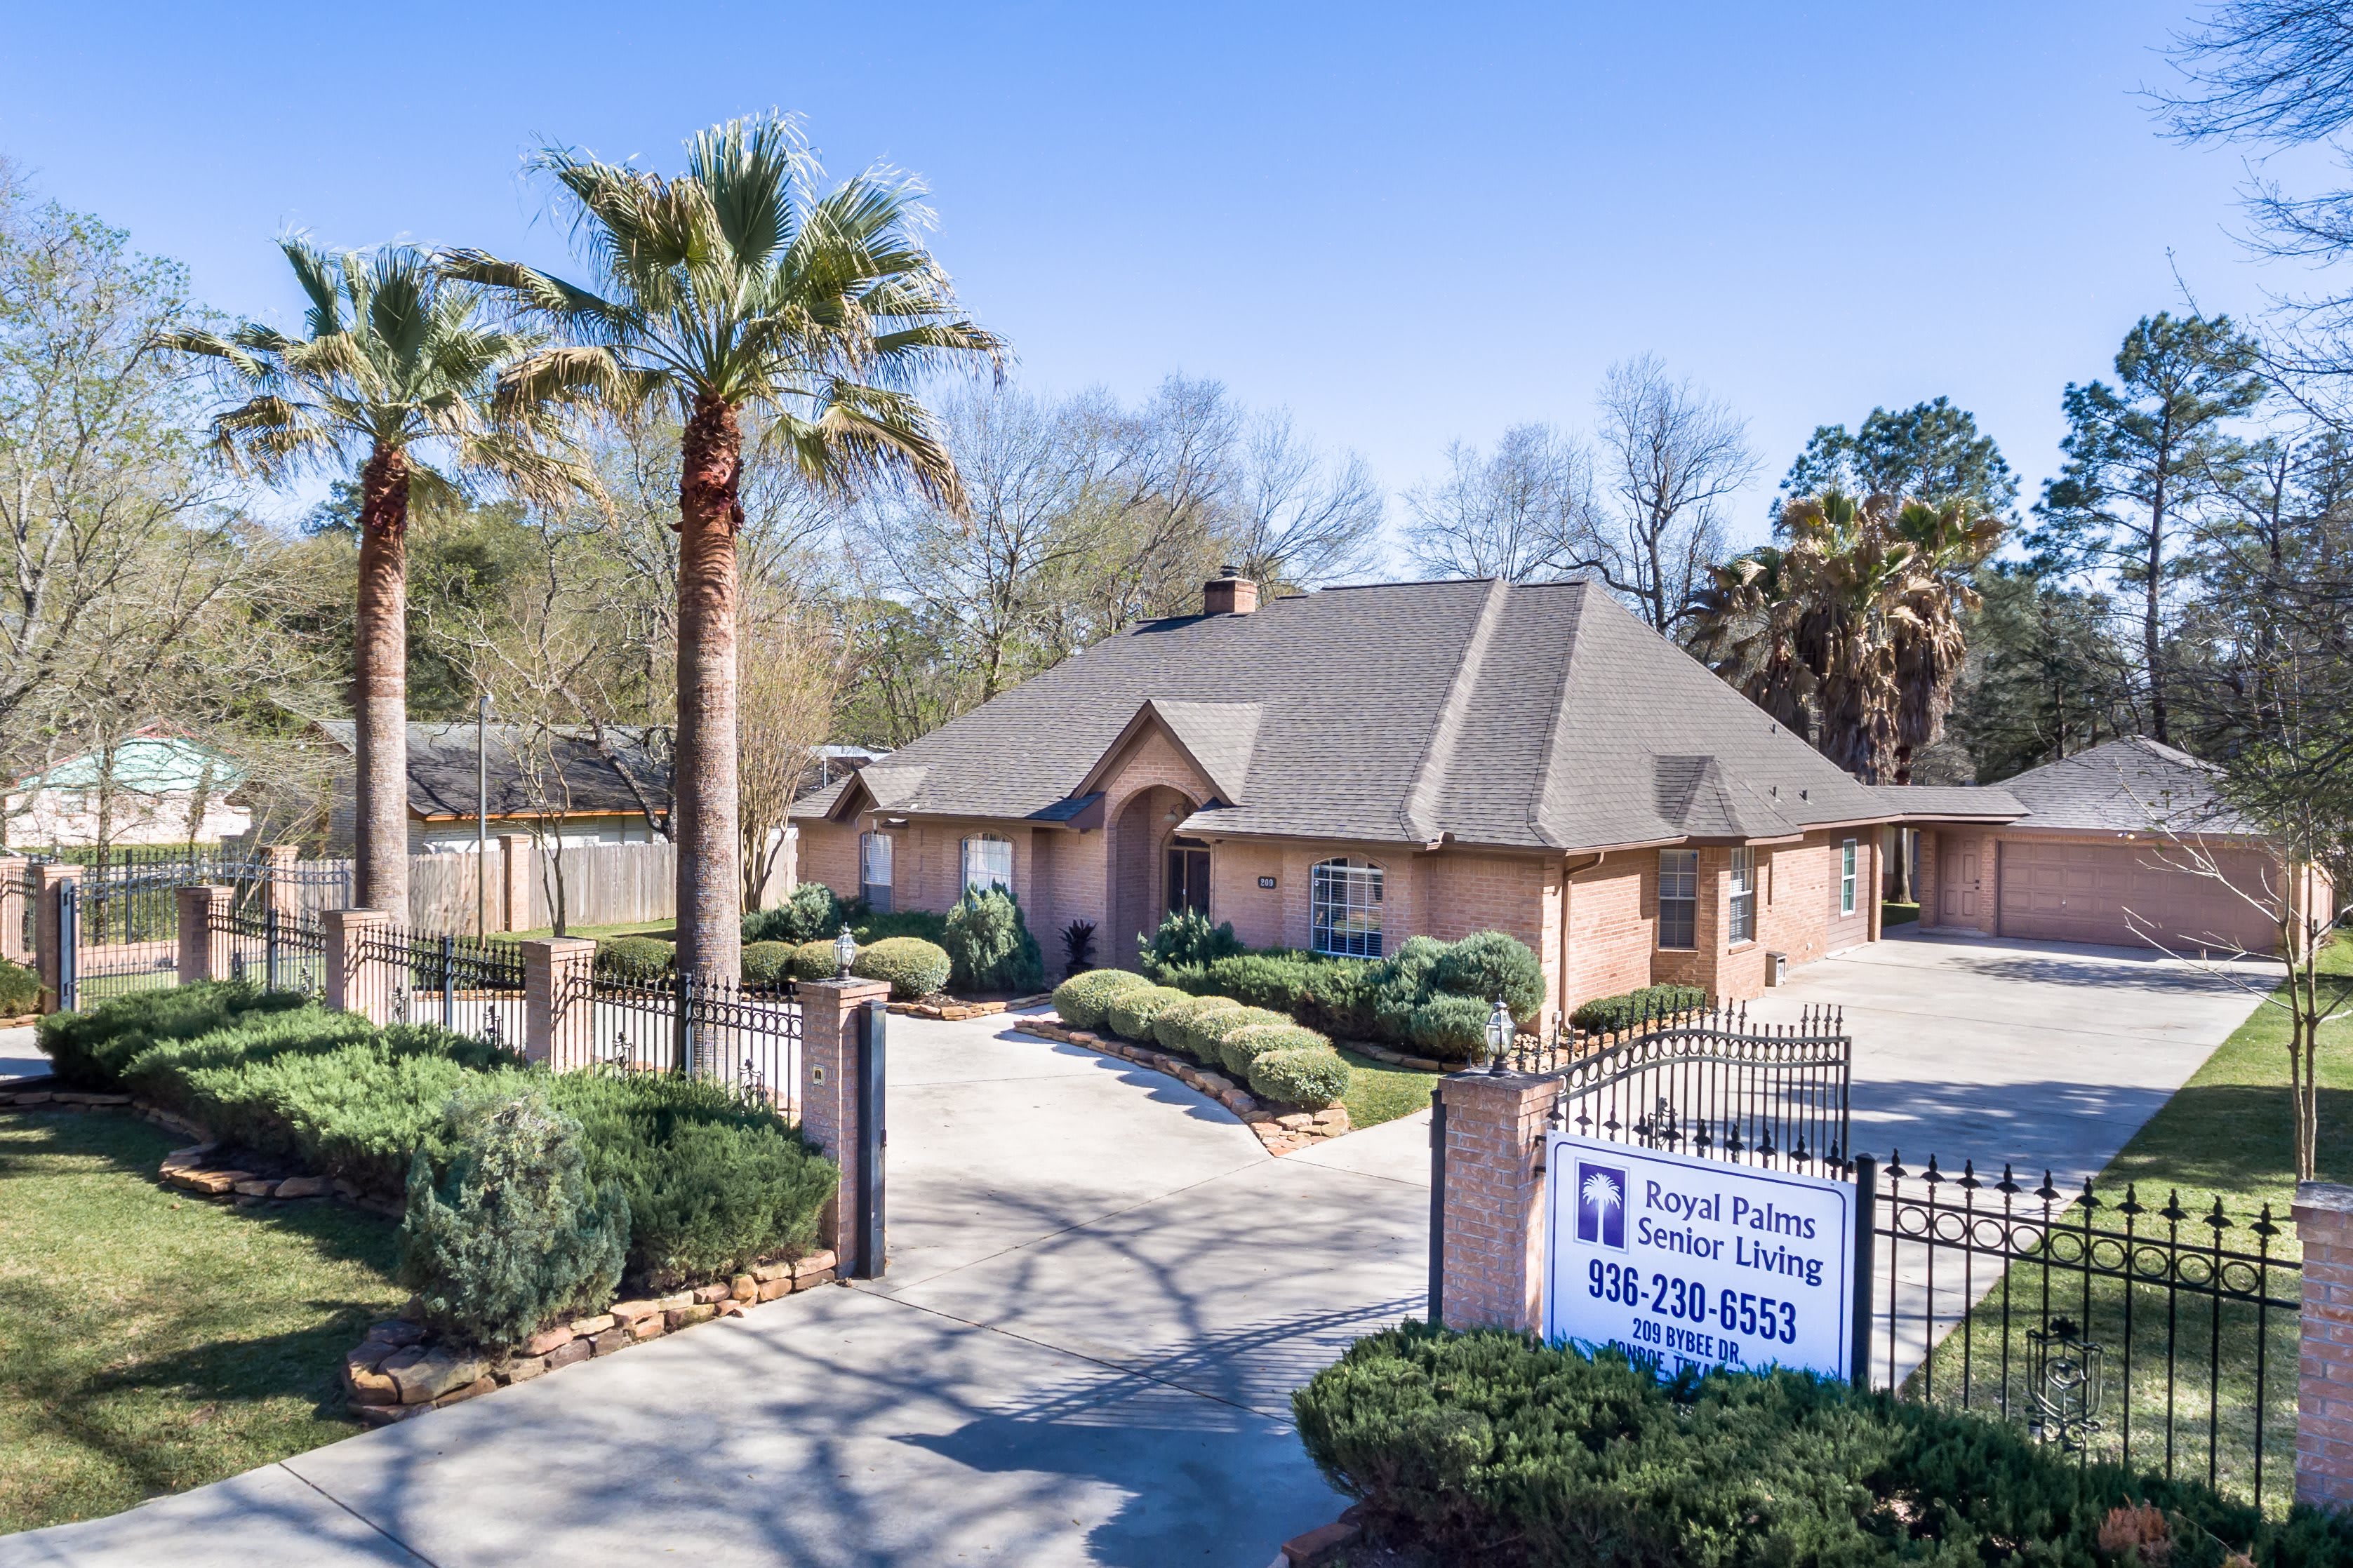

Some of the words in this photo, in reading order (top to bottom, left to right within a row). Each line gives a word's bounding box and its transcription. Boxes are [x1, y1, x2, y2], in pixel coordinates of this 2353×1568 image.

[1260, 878, 1274, 887] 209
[1646, 1180, 1721, 1222] Royal
[1733, 1195, 1816, 1240] Palms
[1638, 1217, 1725, 1261] Senior
[1735, 1235, 1824, 1287] Living
[1589, 1259, 1797, 1345] 936-230-6553
[1632, 1318, 1661, 1345] 209
[1666, 1325, 1714, 1359] BYBEE
